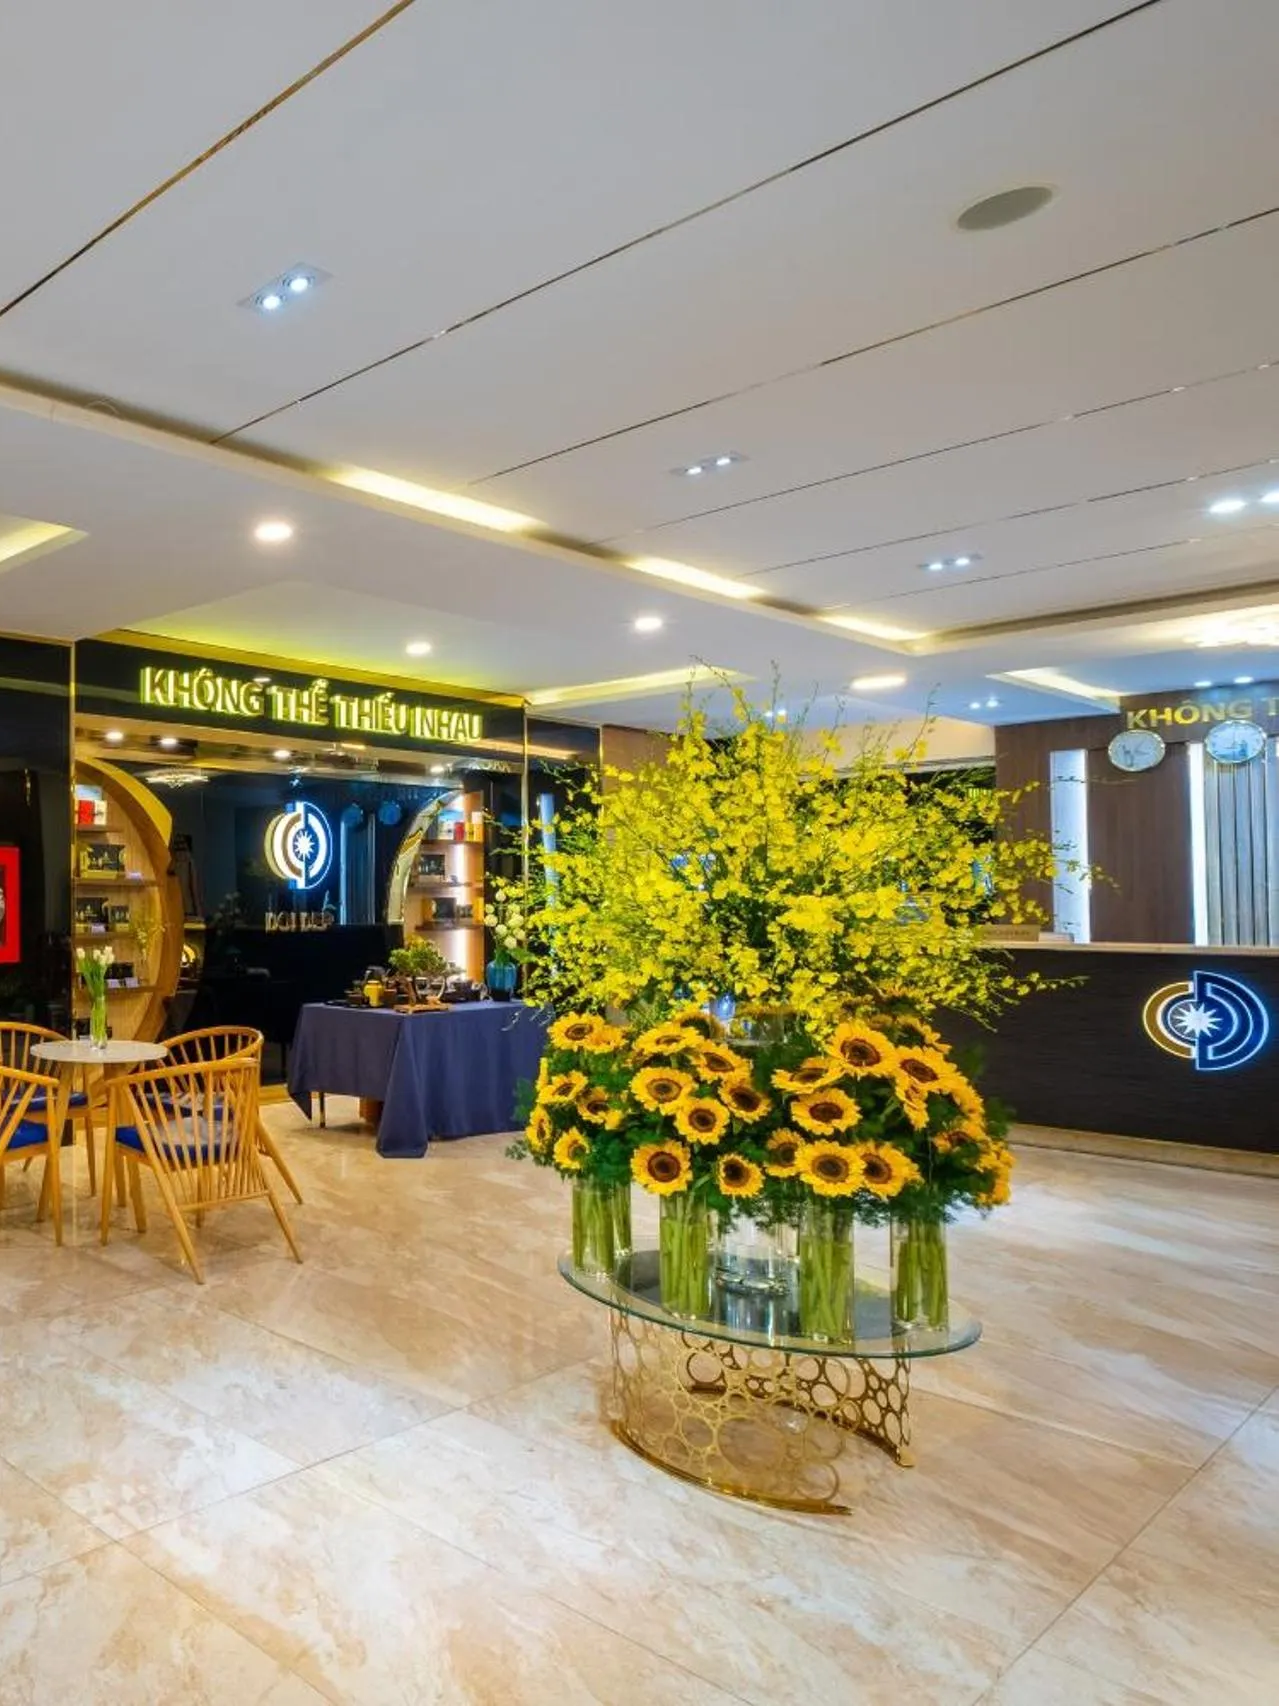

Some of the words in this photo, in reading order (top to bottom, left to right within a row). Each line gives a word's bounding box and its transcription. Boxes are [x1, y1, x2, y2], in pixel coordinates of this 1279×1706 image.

[141, 667, 264, 716] KHÔNG
[410, 706, 484, 743] NHAU
[1127, 700, 1252, 729] KHÔNG
